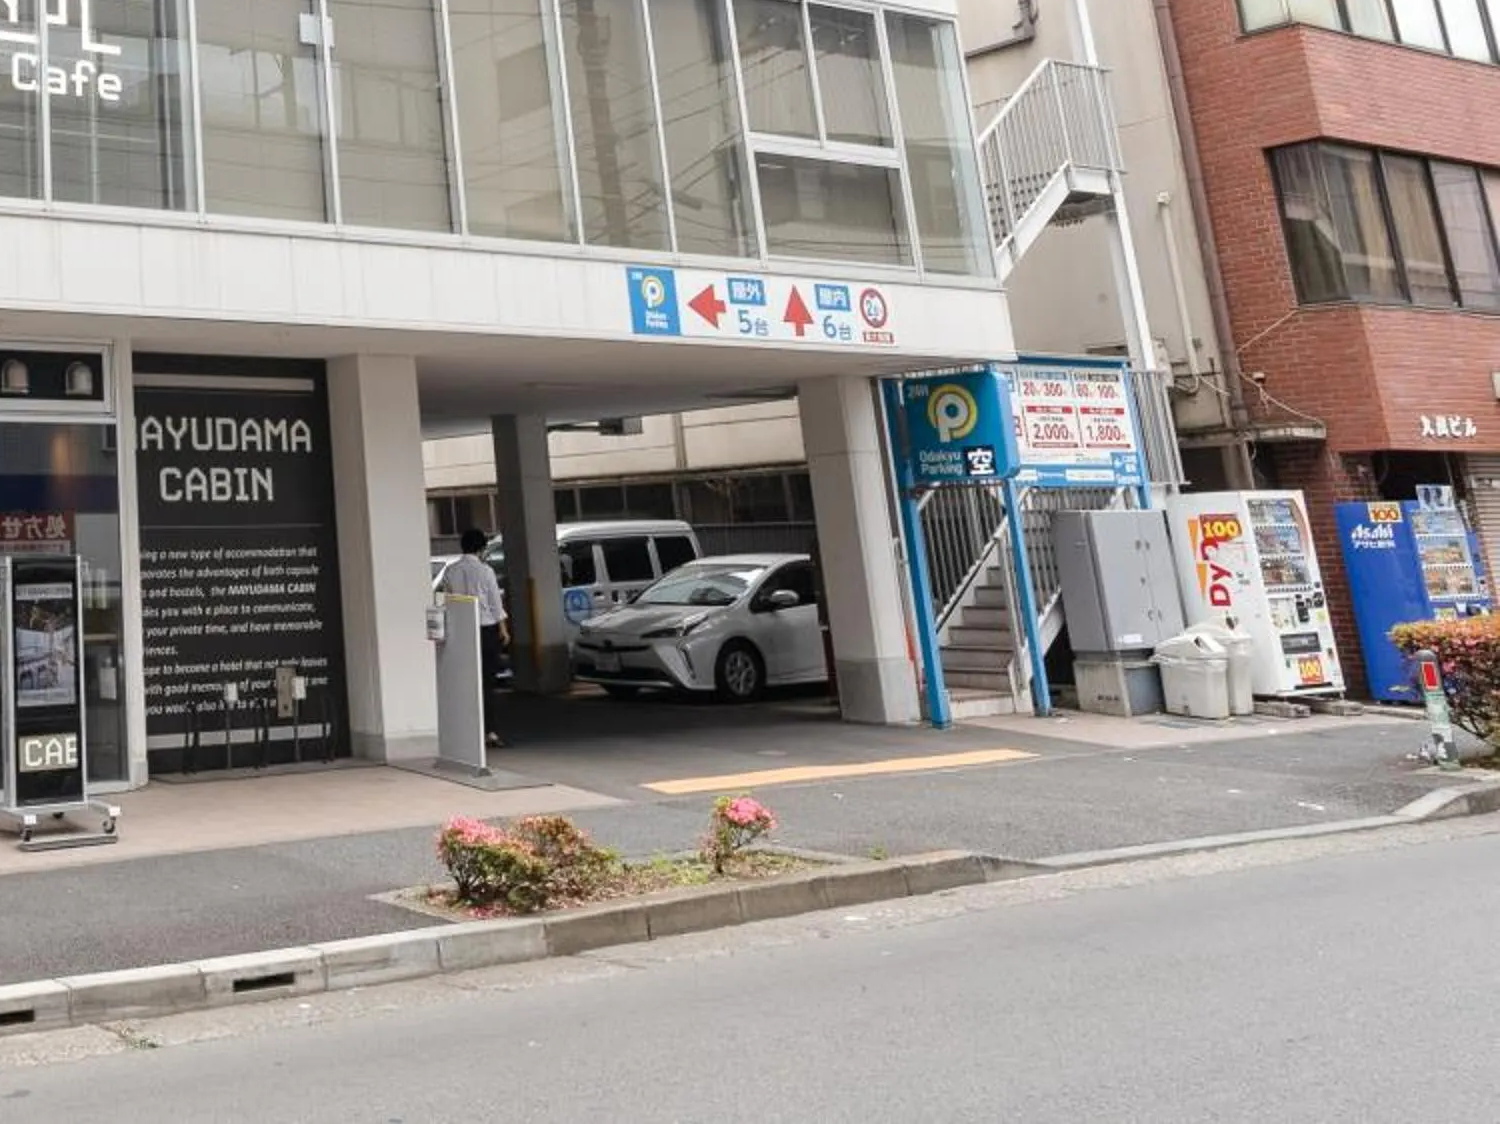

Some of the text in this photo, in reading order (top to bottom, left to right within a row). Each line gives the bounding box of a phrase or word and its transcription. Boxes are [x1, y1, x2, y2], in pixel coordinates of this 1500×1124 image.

[11, 55, 123, 102] Cafe
[134, 415, 313, 454] AYUDAMA
[919, 449, 961, 464] Odakyu
[920, 463, 964, 476] Parking
[967, 447, 995, 476] 空
[159, 466, 275, 502] CABIN
[1203, 520, 1239, 538] 100
[1351, 523, 1394, 539] Asahi
